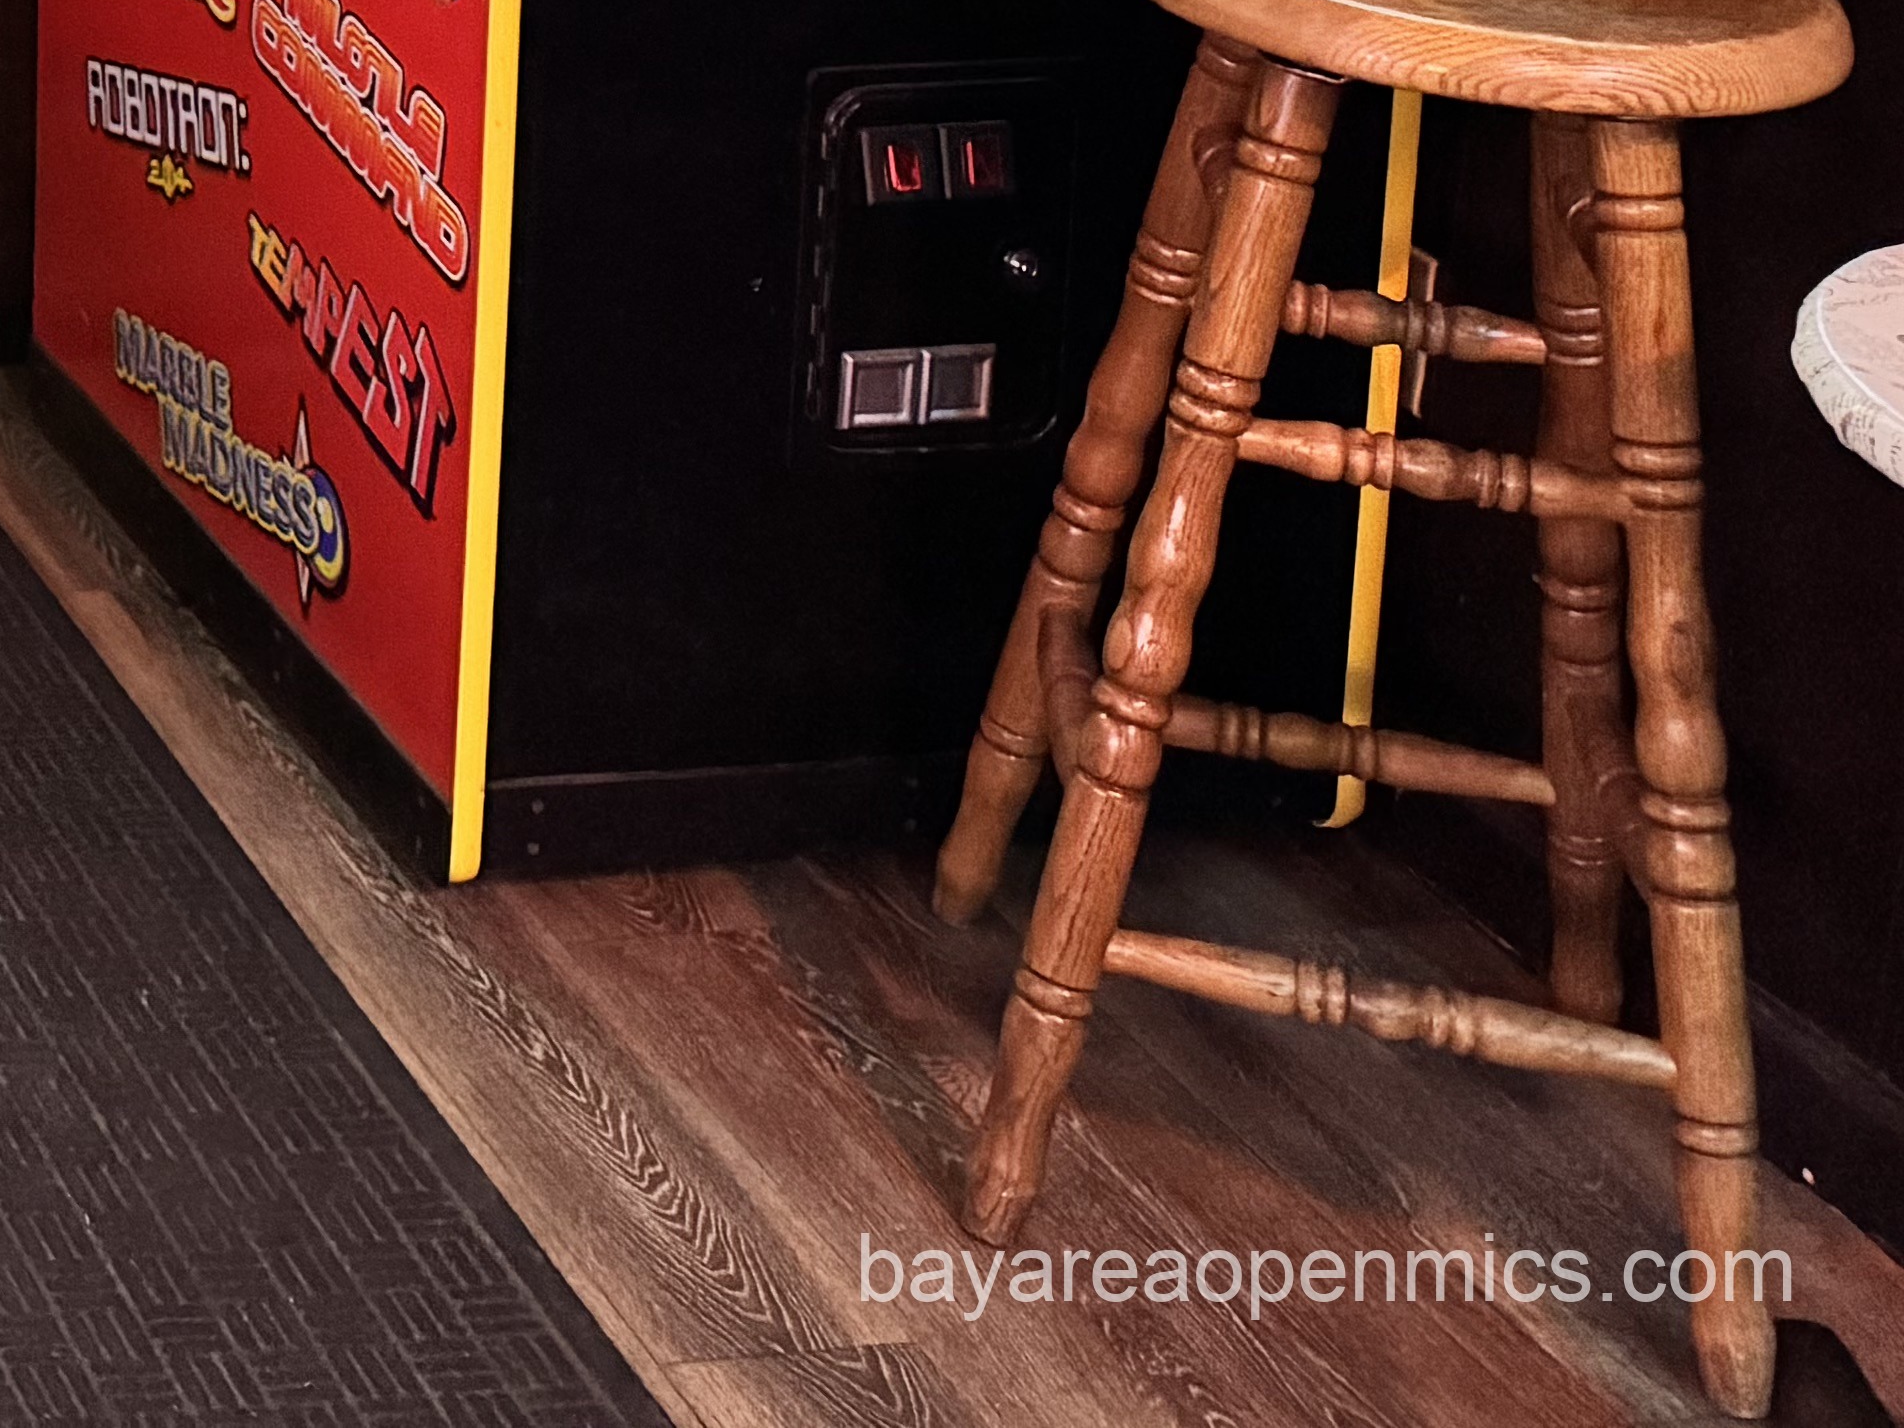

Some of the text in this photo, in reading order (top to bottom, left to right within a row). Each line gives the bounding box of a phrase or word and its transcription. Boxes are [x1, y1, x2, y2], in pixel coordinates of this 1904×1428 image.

[114, 306, 232, 432] MARBLE
[248, 212, 458, 519] TEMPEST
[162, 402, 324, 566] MADNESS
